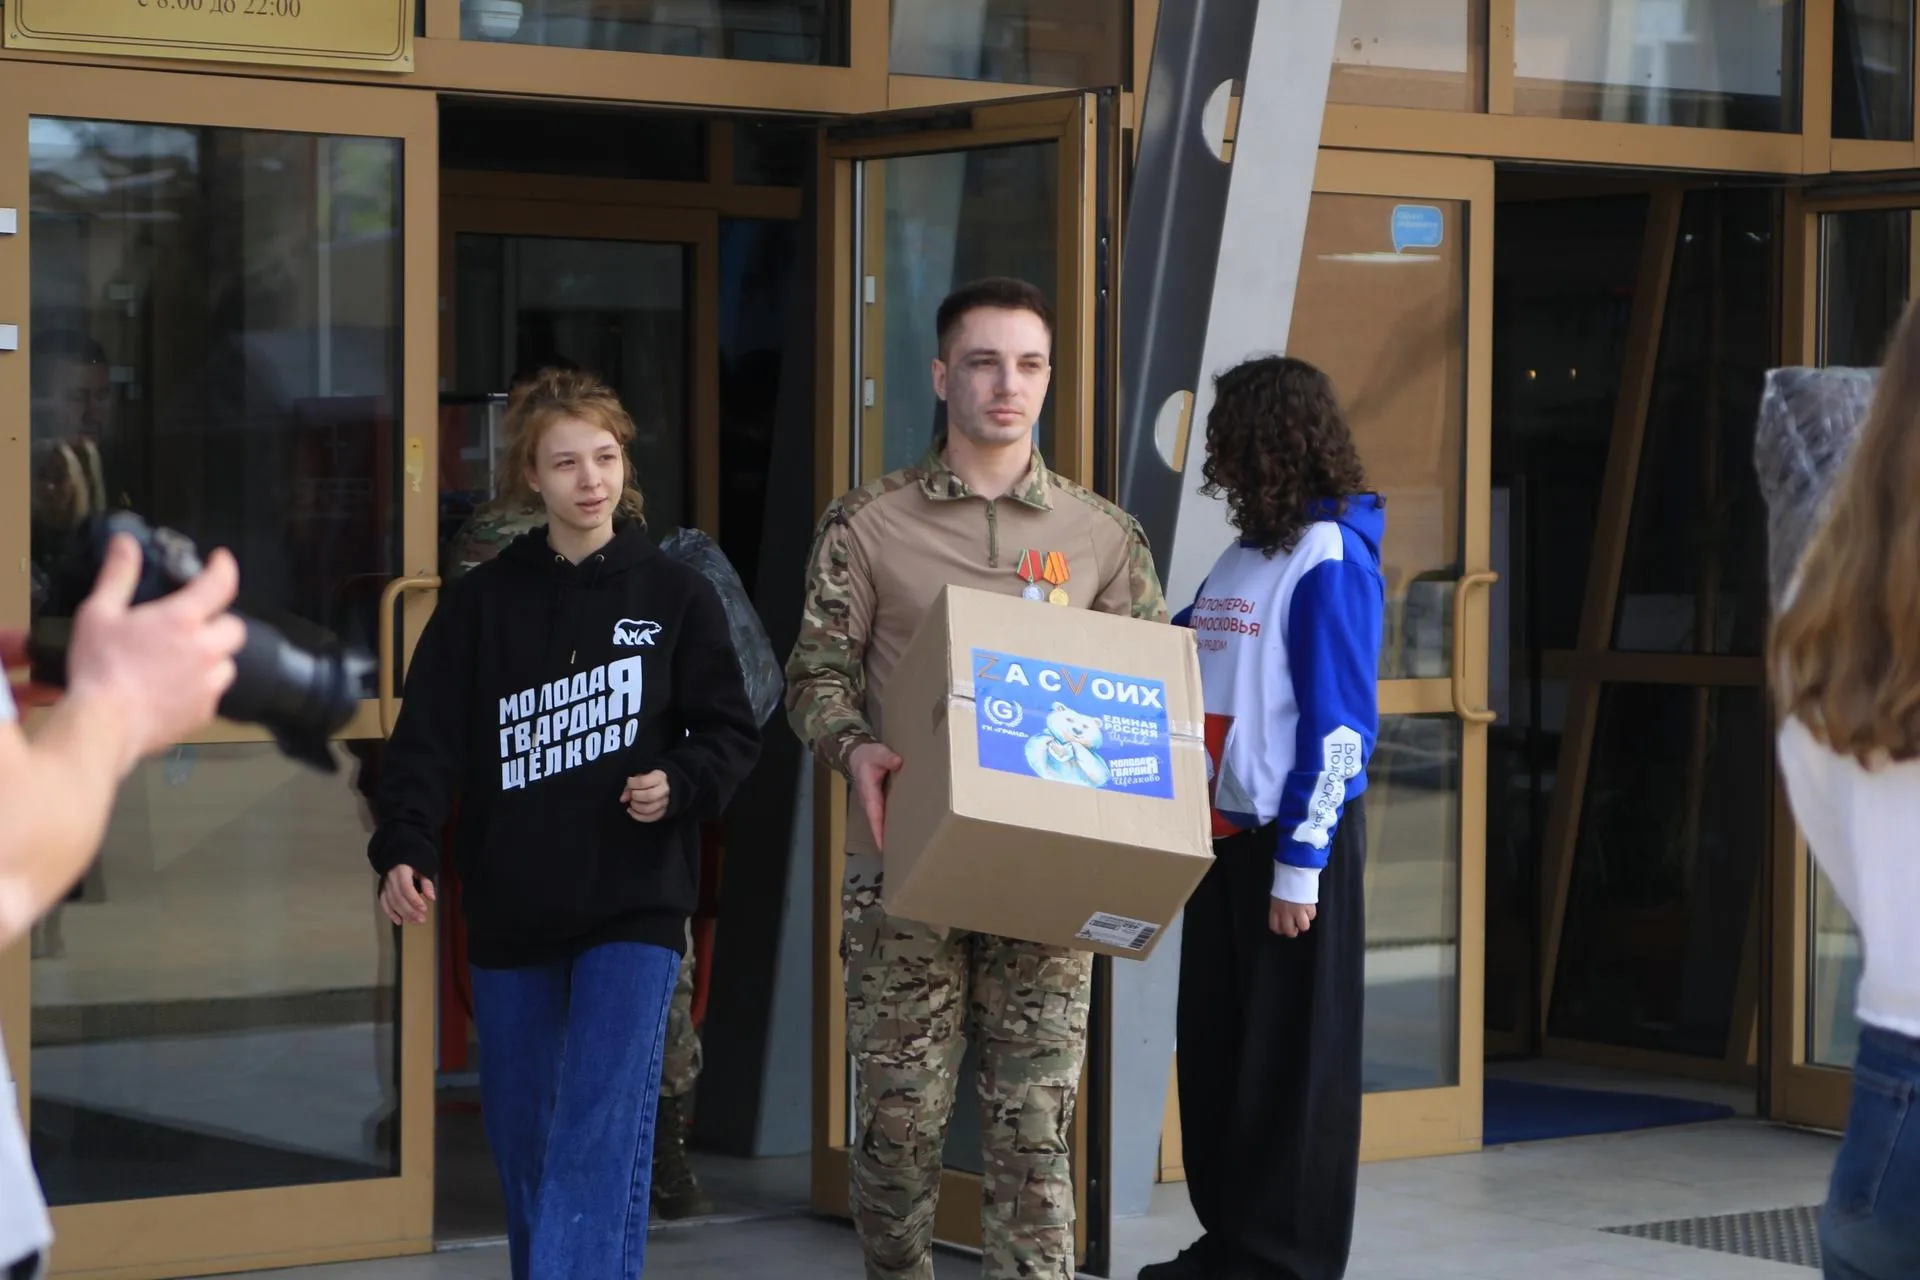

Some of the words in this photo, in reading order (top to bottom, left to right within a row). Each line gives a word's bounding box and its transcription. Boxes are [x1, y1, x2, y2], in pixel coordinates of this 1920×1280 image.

[209, 0, 235, 14] до
[243, 0, 301, 17] 22:00
[1195, 596, 1256, 614] ОЛОНТЕРЫ
[1189, 615, 1261, 637] ДМОСКОВЬЯ
[1103, 714, 1158, 730] ЕДИНАЯ
[1104, 722, 1158, 738] РОССИЯ
[502, 718, 639, 790] ЩЁЛКОВО
